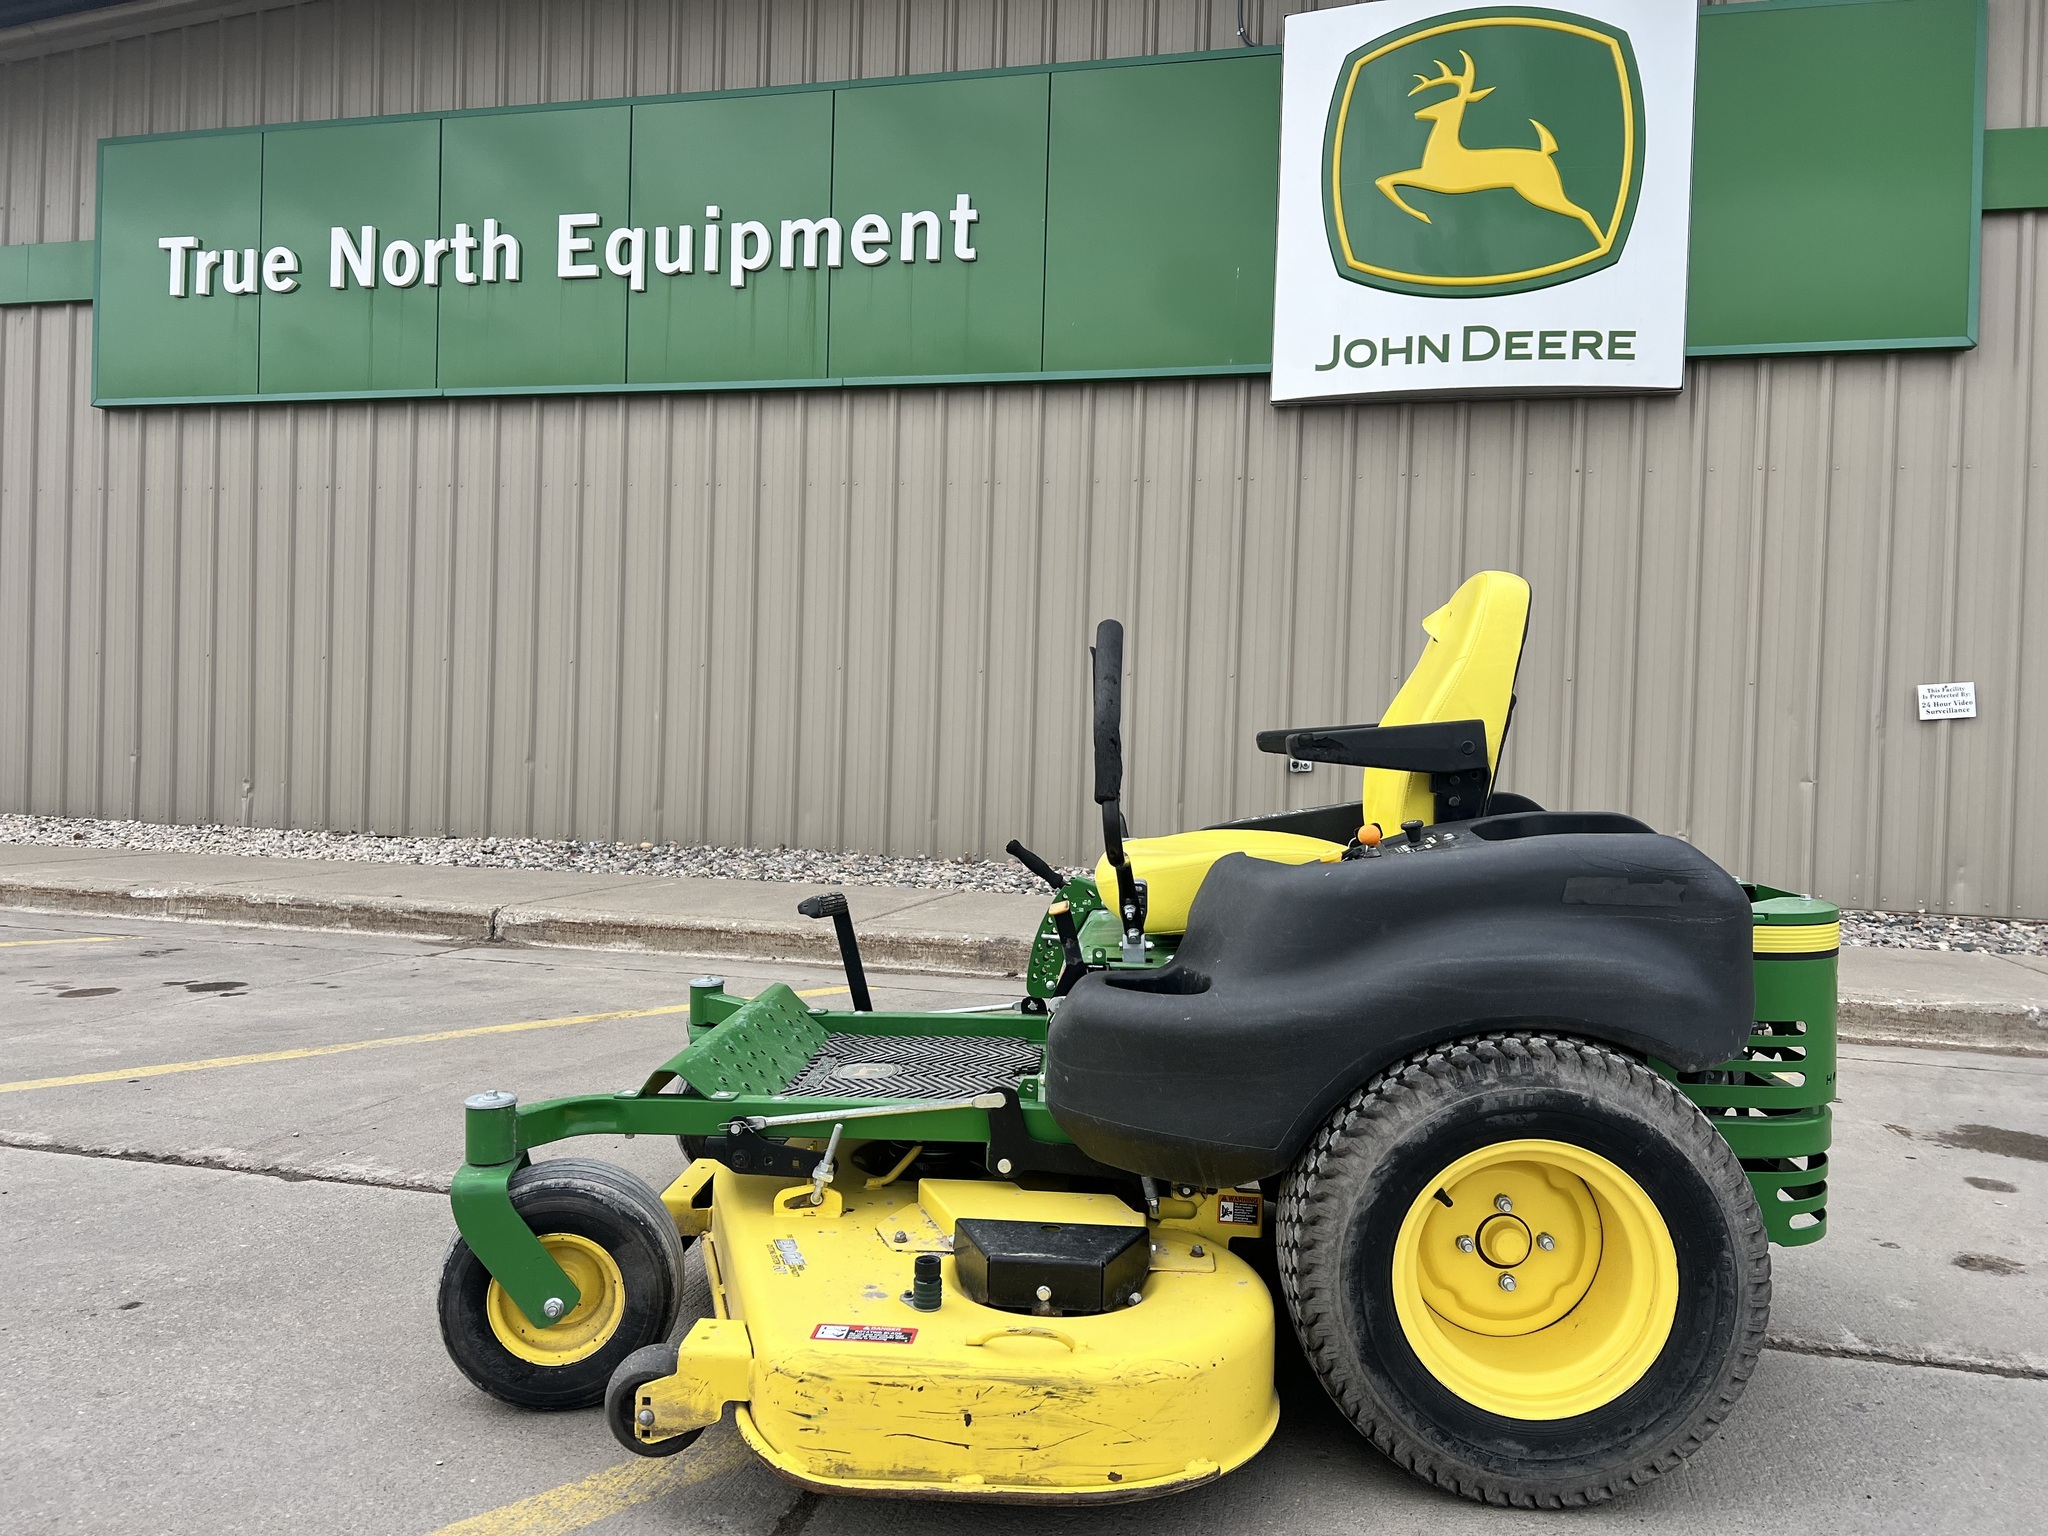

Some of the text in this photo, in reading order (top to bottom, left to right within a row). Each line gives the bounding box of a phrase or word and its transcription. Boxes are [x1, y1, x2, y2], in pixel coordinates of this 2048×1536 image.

[158, 192, 979, 298] True North Equipment
[1314, 324, 1638, 372] JOHN DEERE
